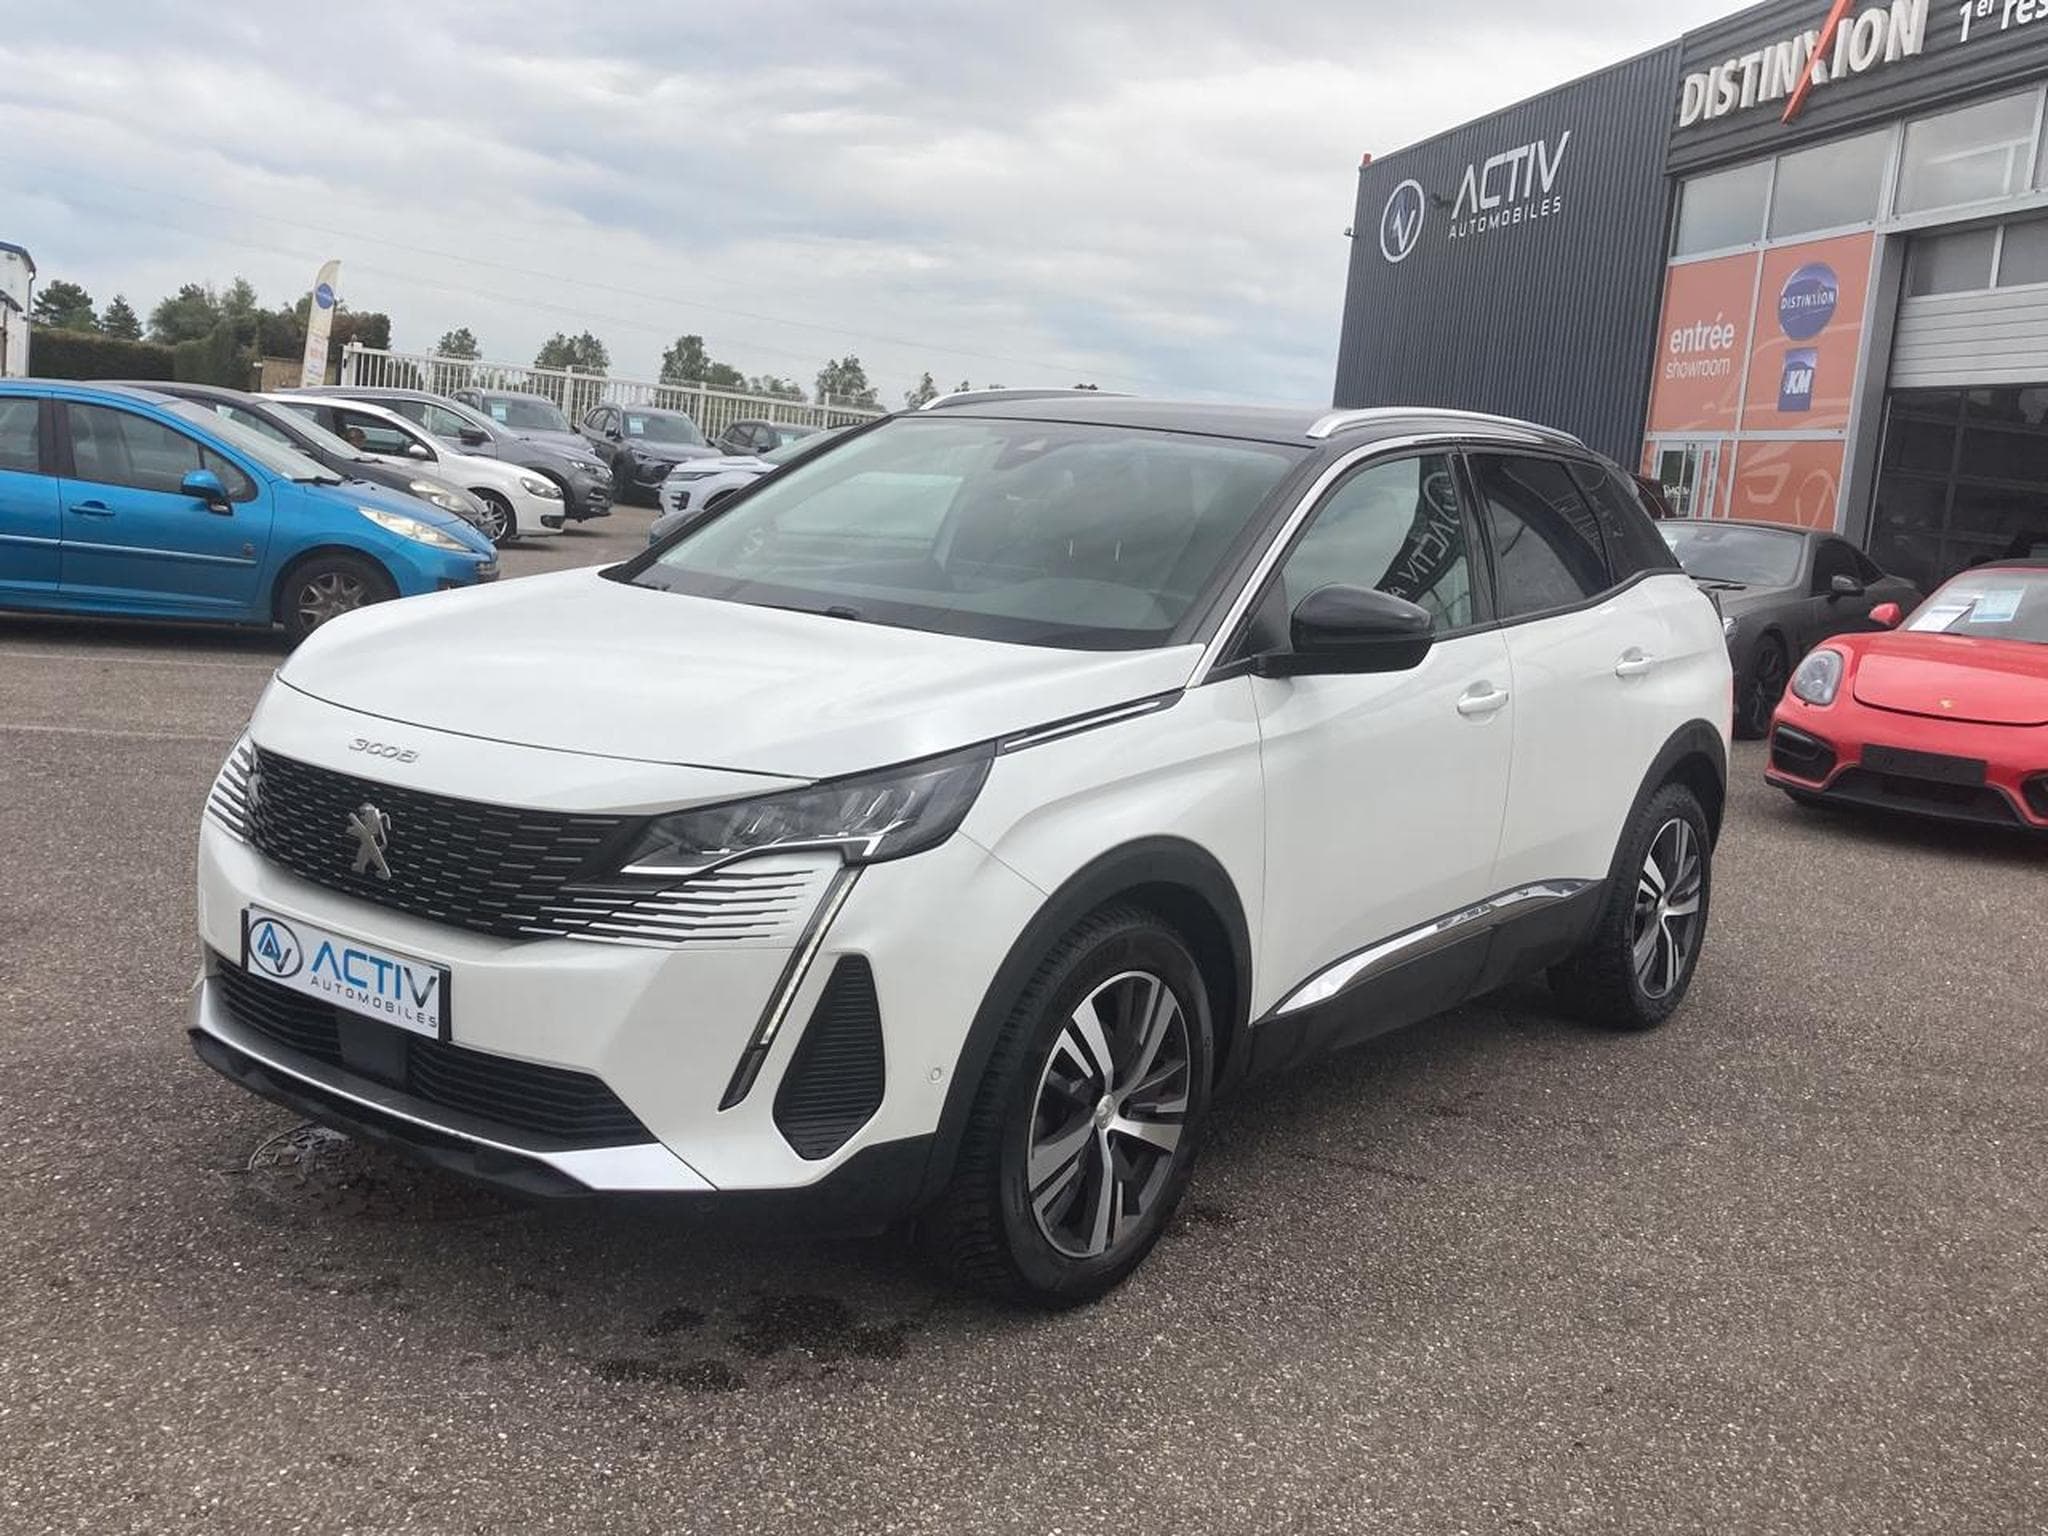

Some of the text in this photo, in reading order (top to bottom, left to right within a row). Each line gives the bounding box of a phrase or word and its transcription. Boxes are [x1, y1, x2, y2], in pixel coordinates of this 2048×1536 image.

[1679, 0, 1930, 127] DISTINXION
[1451, 131, 1570, 220] ACTIV
[1448, 196, 1561, 239] AUTOMOBILES
[1669, 312, 1735, 354] entrée
[1665, 357, 1730, 379] showroom
[348, 738, 421, 764] 3008
[311, 941, 437, 1008] ACTIV
[311, 976, 437, 1028] AUTOMOBILES
